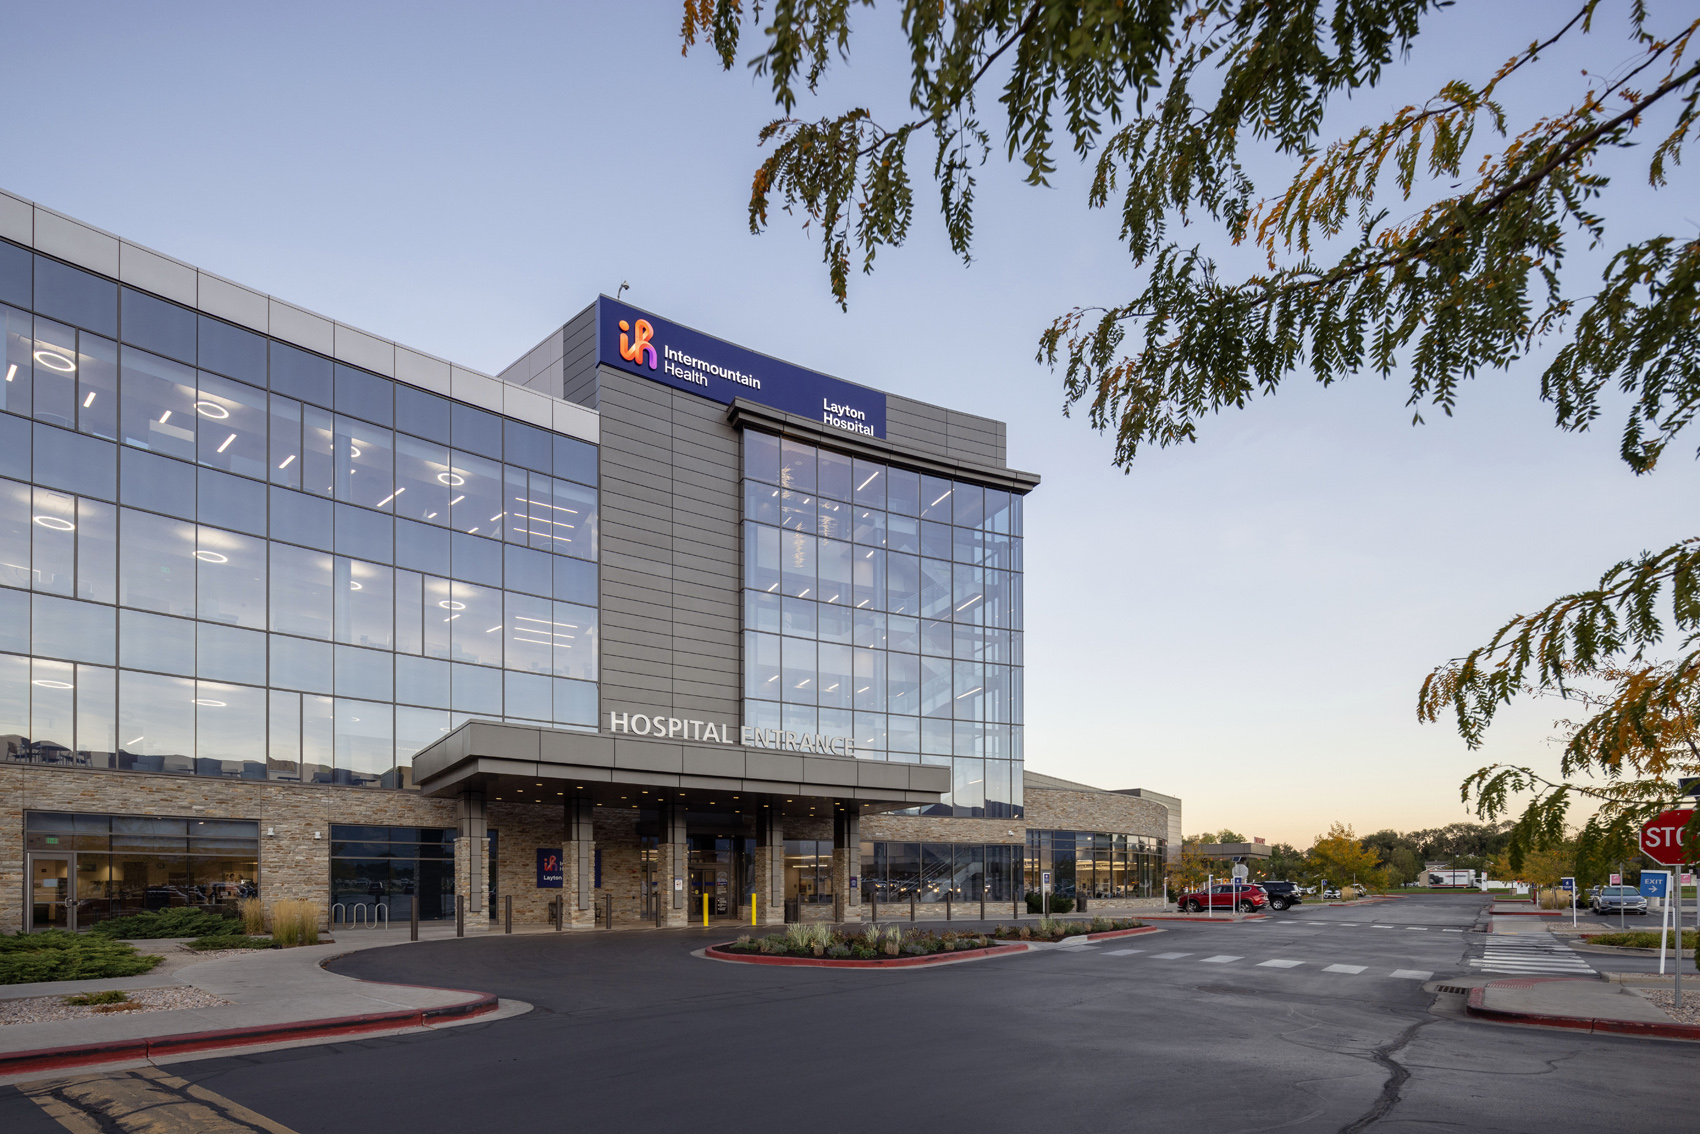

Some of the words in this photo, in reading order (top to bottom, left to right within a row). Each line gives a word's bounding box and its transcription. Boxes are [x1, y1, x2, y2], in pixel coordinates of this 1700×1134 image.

[665, 345, 761, 389] Intermountain
[665, 360, 708, 387] Health
[823, 398, 866, 421] Layton
[823, 412, 874, 436] Hospital
[610, 711, 734, 744] HOSPITAL
[741, 726, 855, 757] ENTRANCE
[1645, 827, 1686, 847] ST
